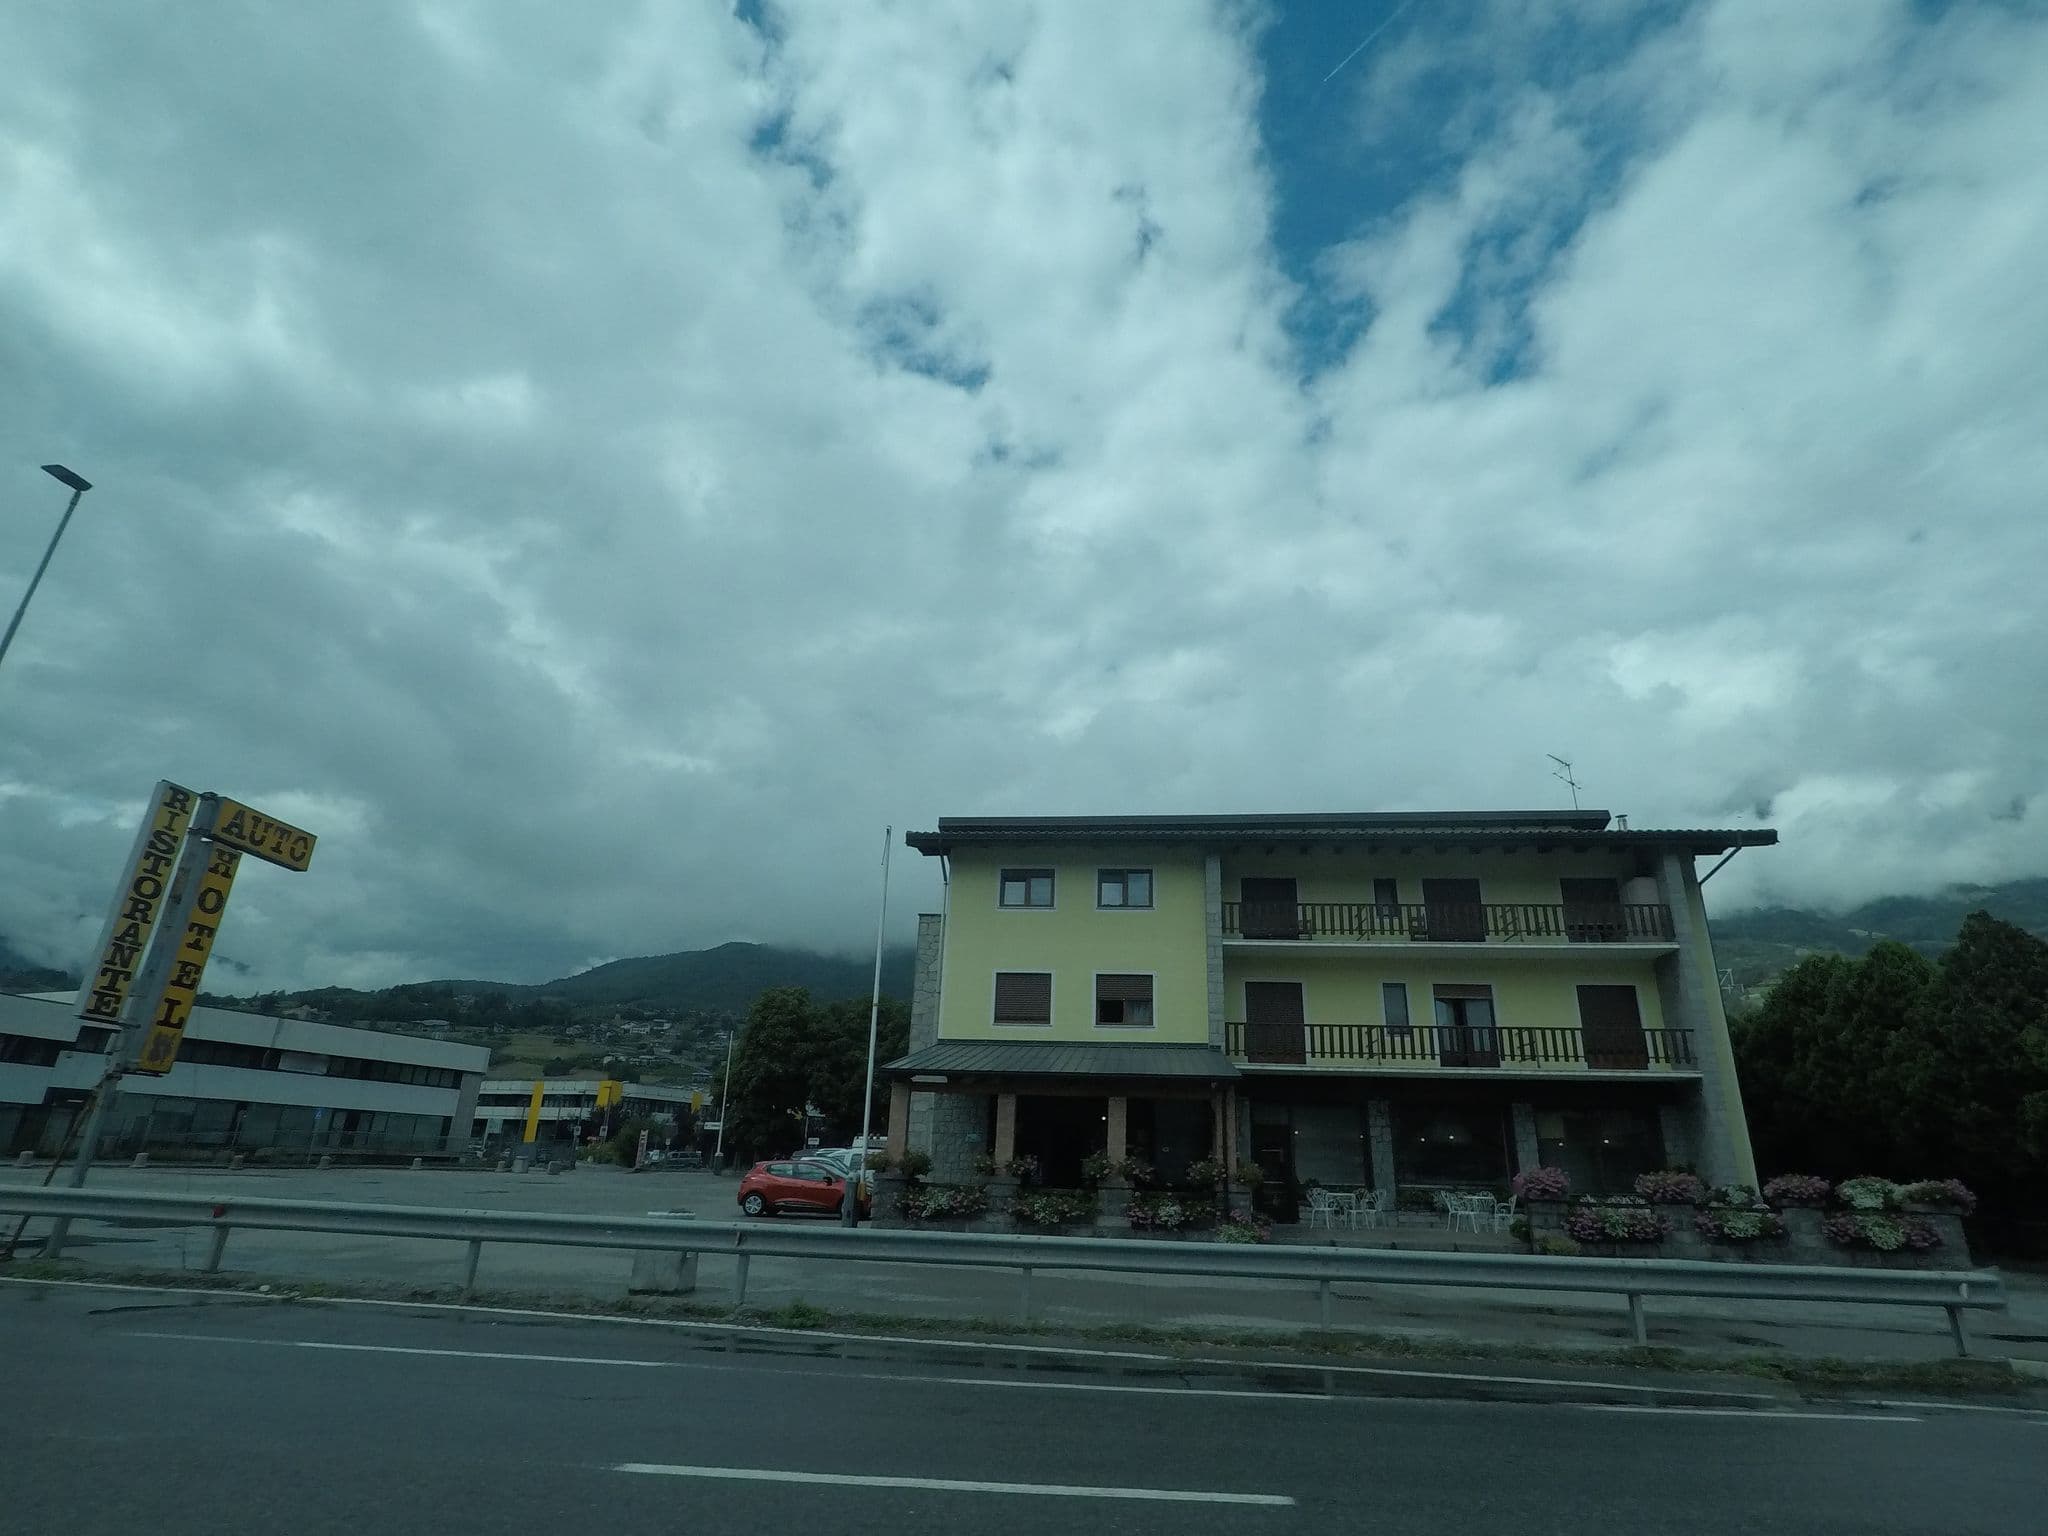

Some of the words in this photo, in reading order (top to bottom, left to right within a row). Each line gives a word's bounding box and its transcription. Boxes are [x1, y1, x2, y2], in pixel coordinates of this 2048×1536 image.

[86, 786, 191, 1018] RISTORANTE
[221, 808, 310, 863] AUTO
[156, 848, 242, 1029] HOTEL
